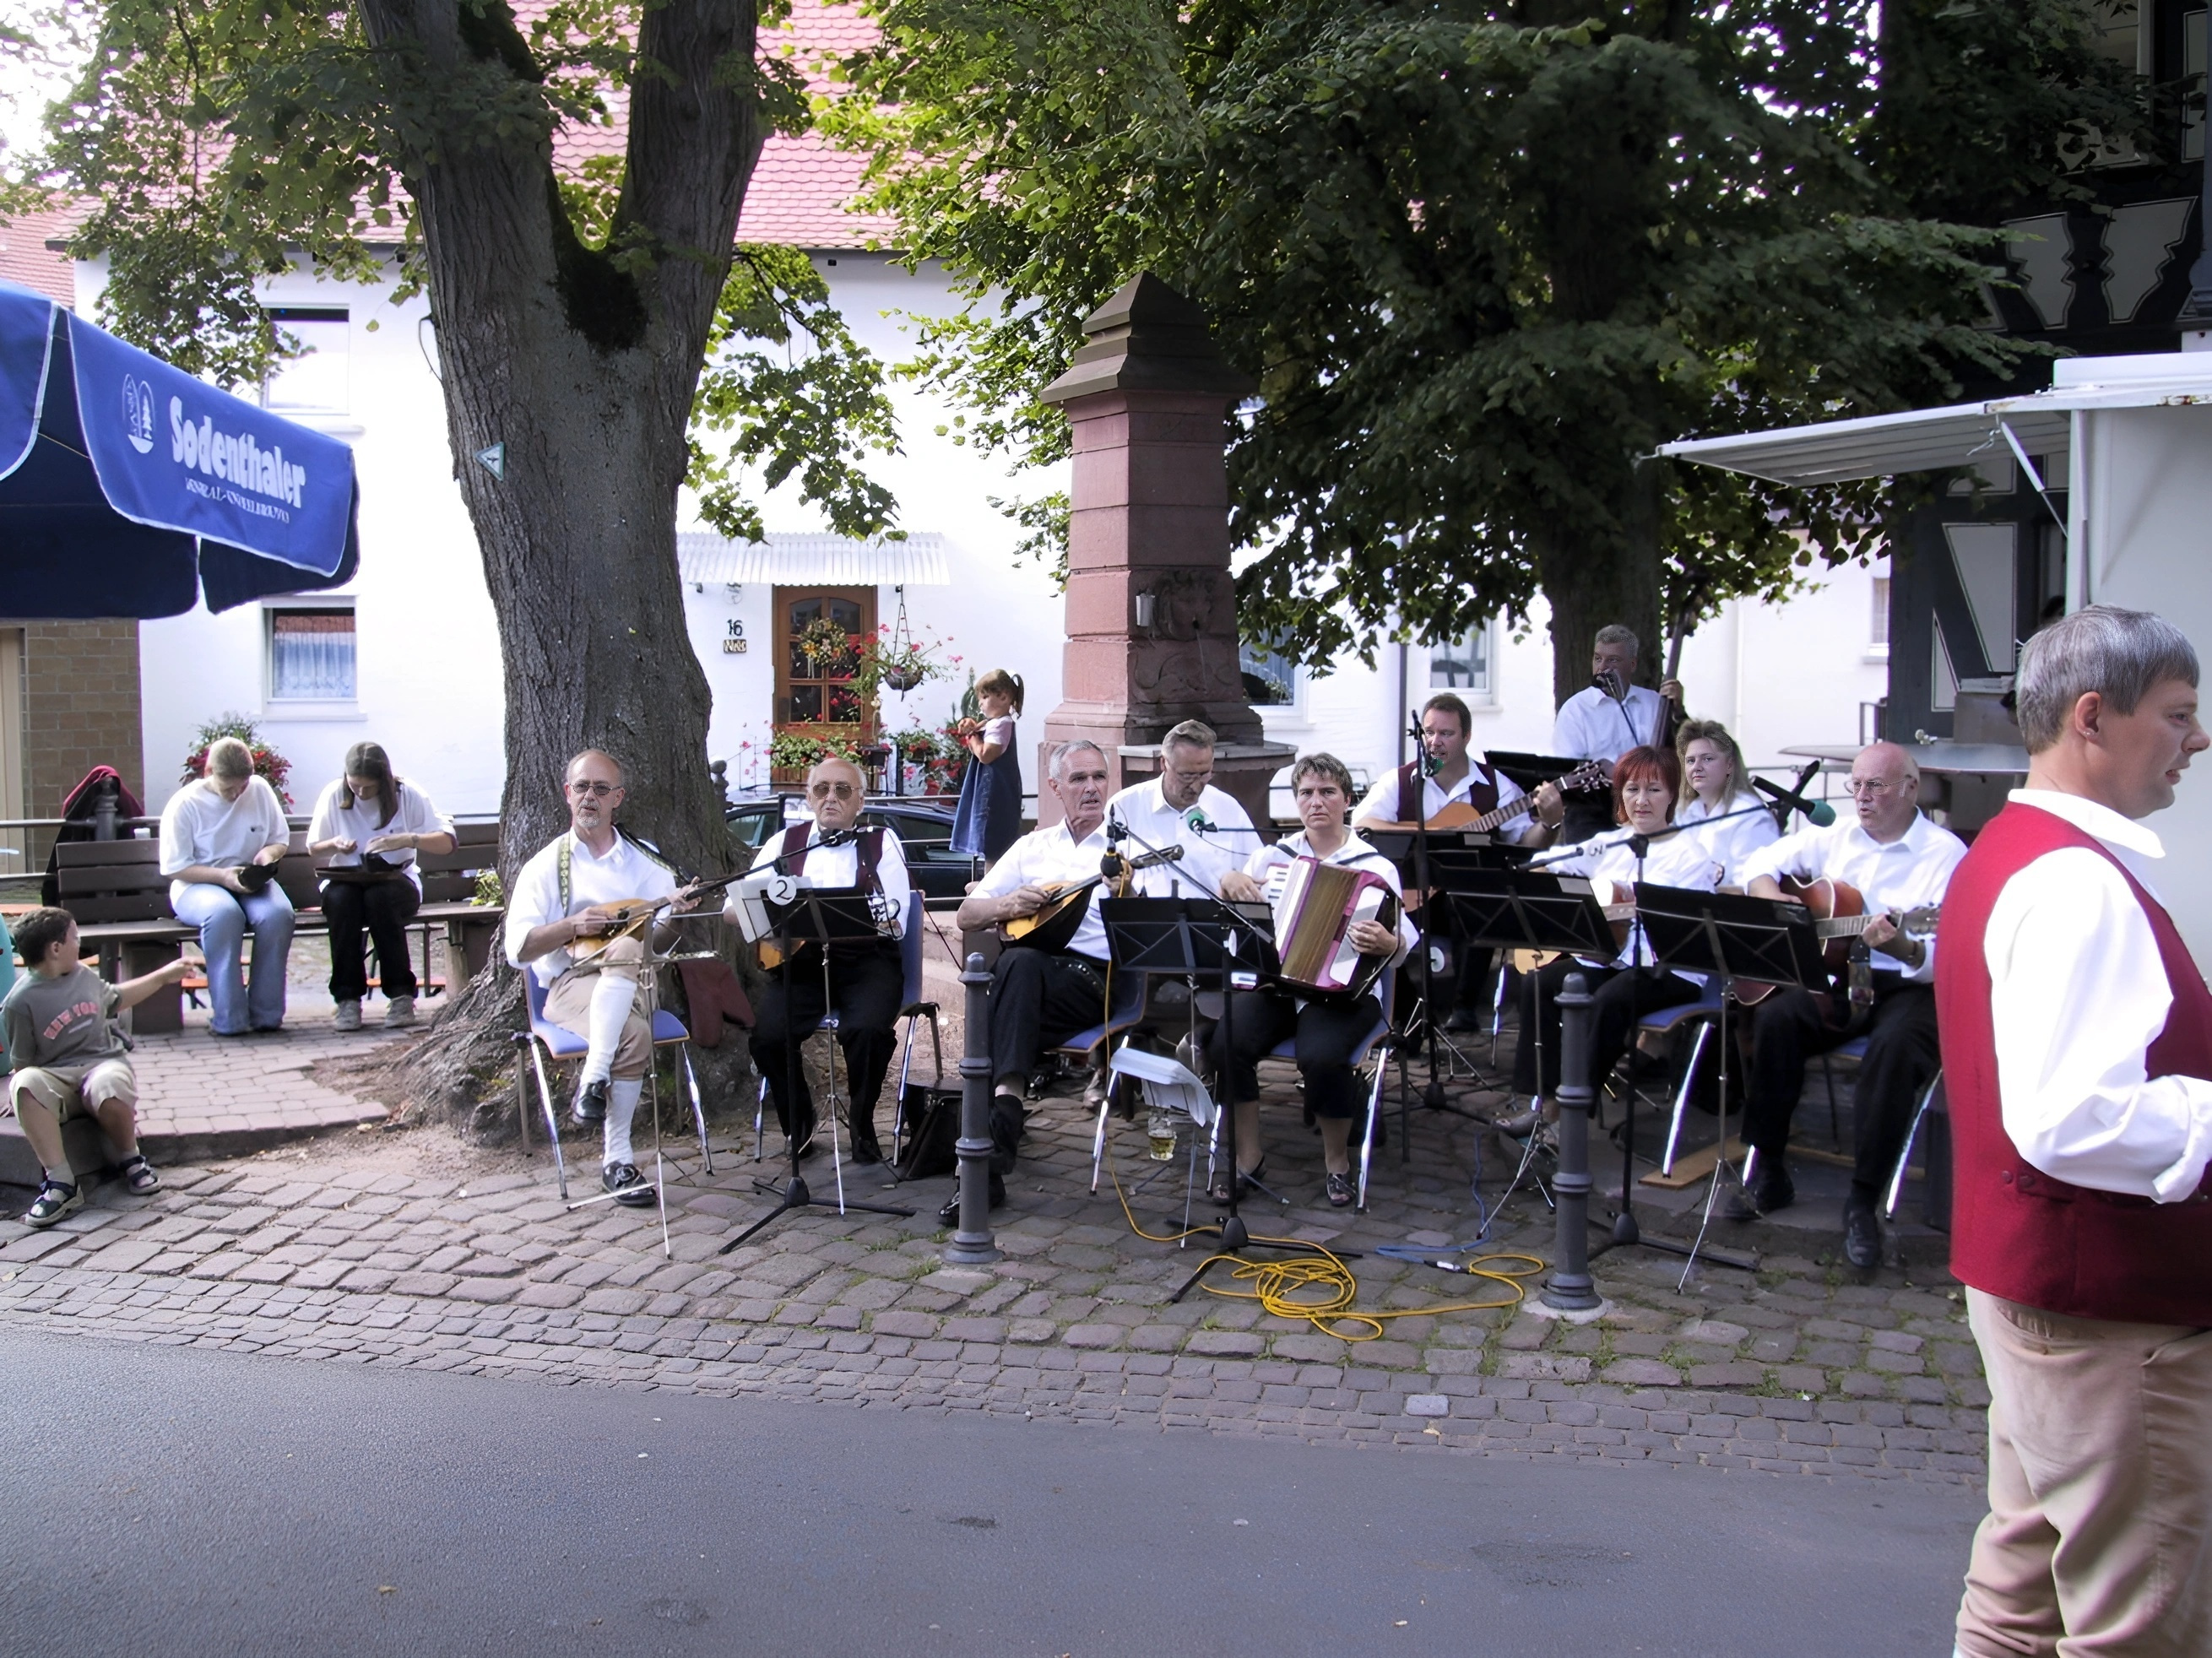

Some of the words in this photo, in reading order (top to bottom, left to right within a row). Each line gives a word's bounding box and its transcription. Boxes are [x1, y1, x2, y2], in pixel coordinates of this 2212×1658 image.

[170, 395, 306, 509] Sodenthaler
[727, 619, 743, 637] 16
[775, 879, 792, 901] 2
